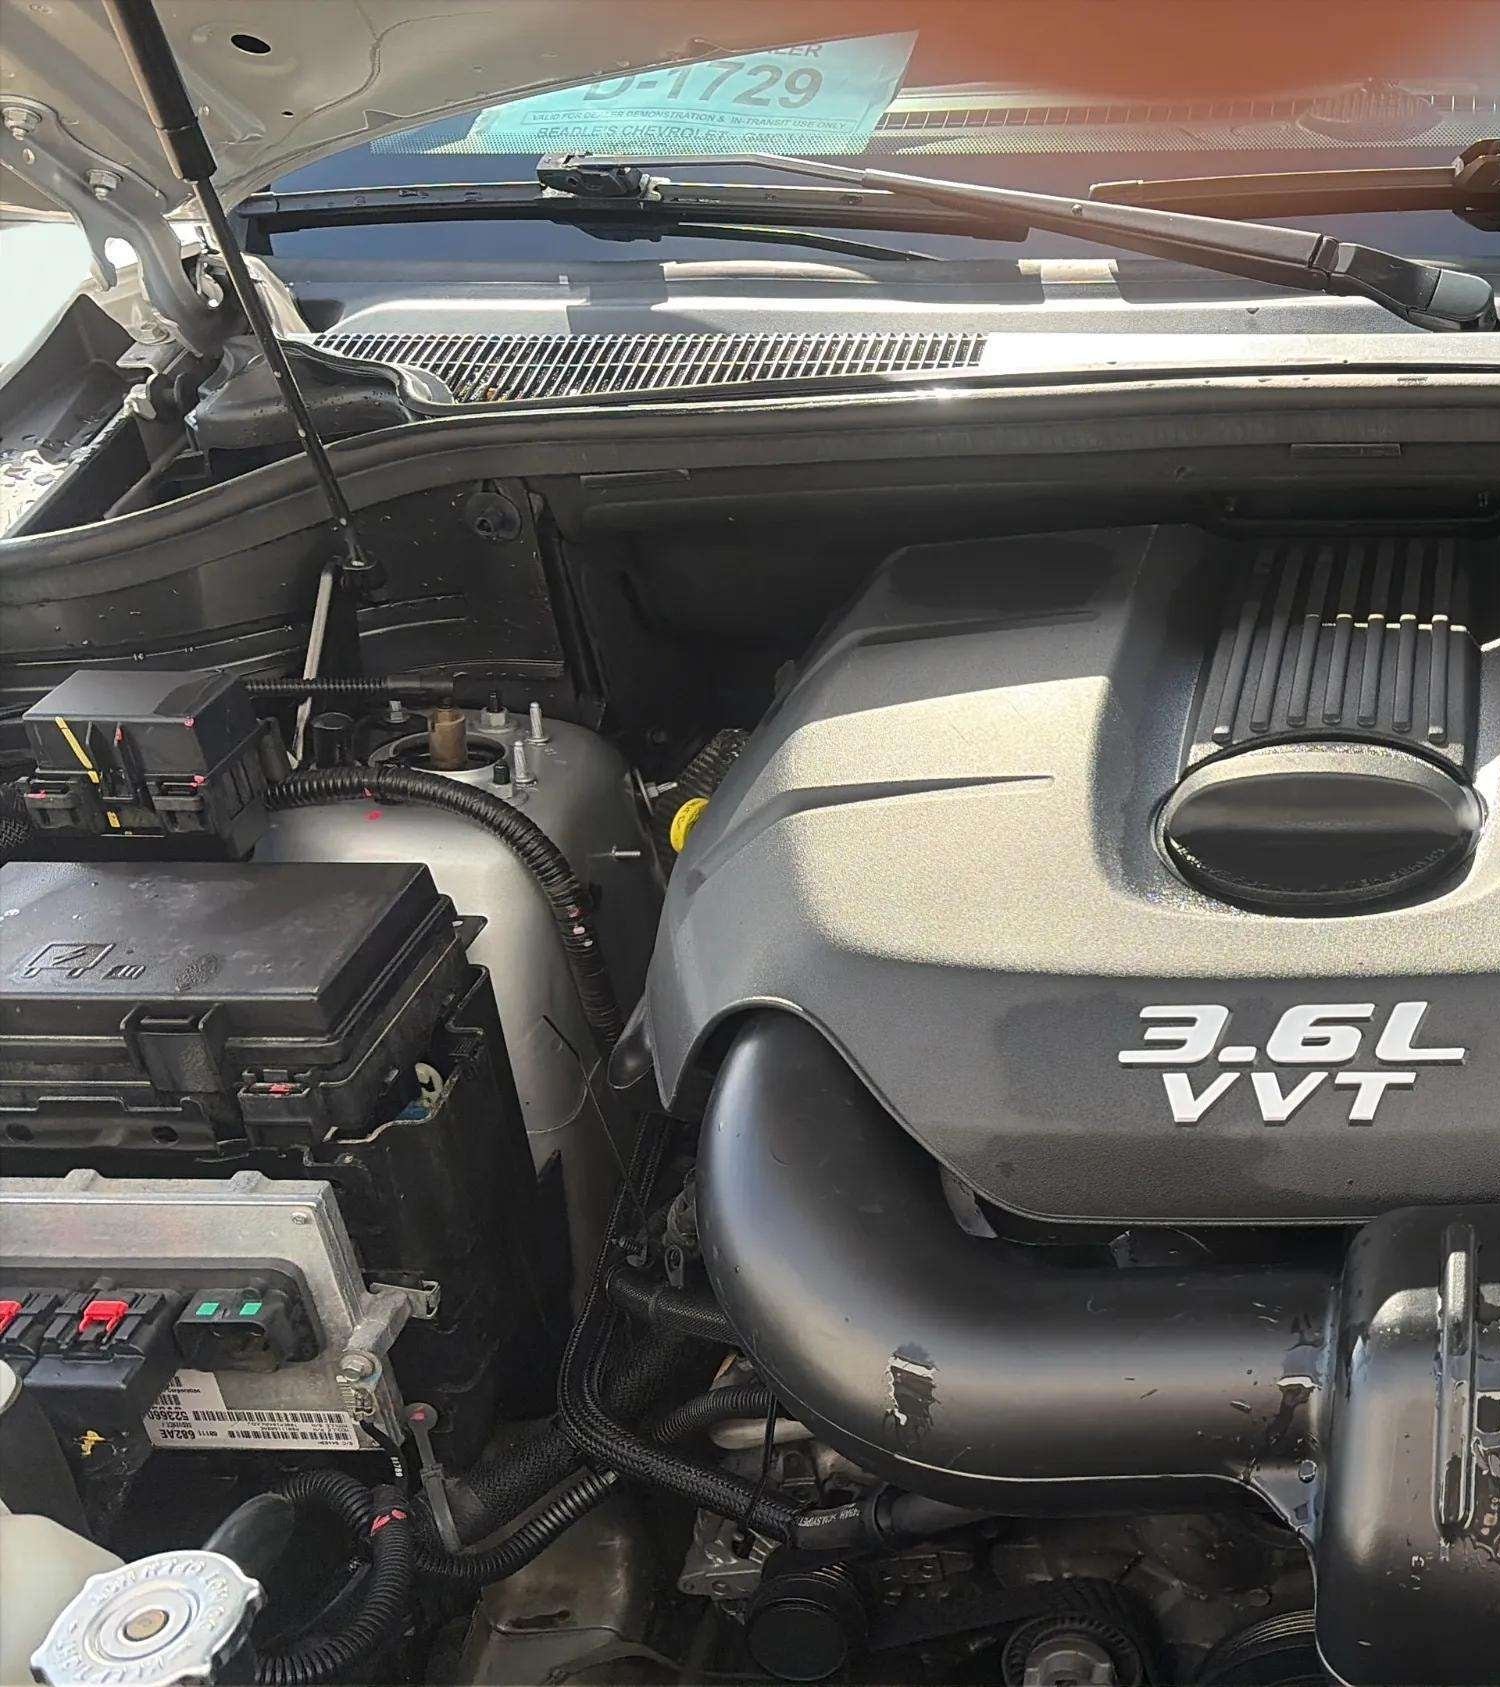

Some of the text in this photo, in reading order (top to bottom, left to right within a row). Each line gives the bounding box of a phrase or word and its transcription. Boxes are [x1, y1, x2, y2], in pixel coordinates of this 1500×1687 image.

[532, 112, 559, 122] VALID
[561, 112, 582, 121] FOR
[626, 109, 716, 122] DEMONSTRATION
[731, 117, 789, 128] IN-TRANSIT
[793, 119, 816, 128] USE
[817, 121, 847, 130] ONLY
[621, 124, 729, 142] CHEVROLET
[1118, 1001, 1466, 1065] 3.6L
[1162, 1071, 1417, 1125] VVT
[160, 1429, 196, 1440] 682AE
